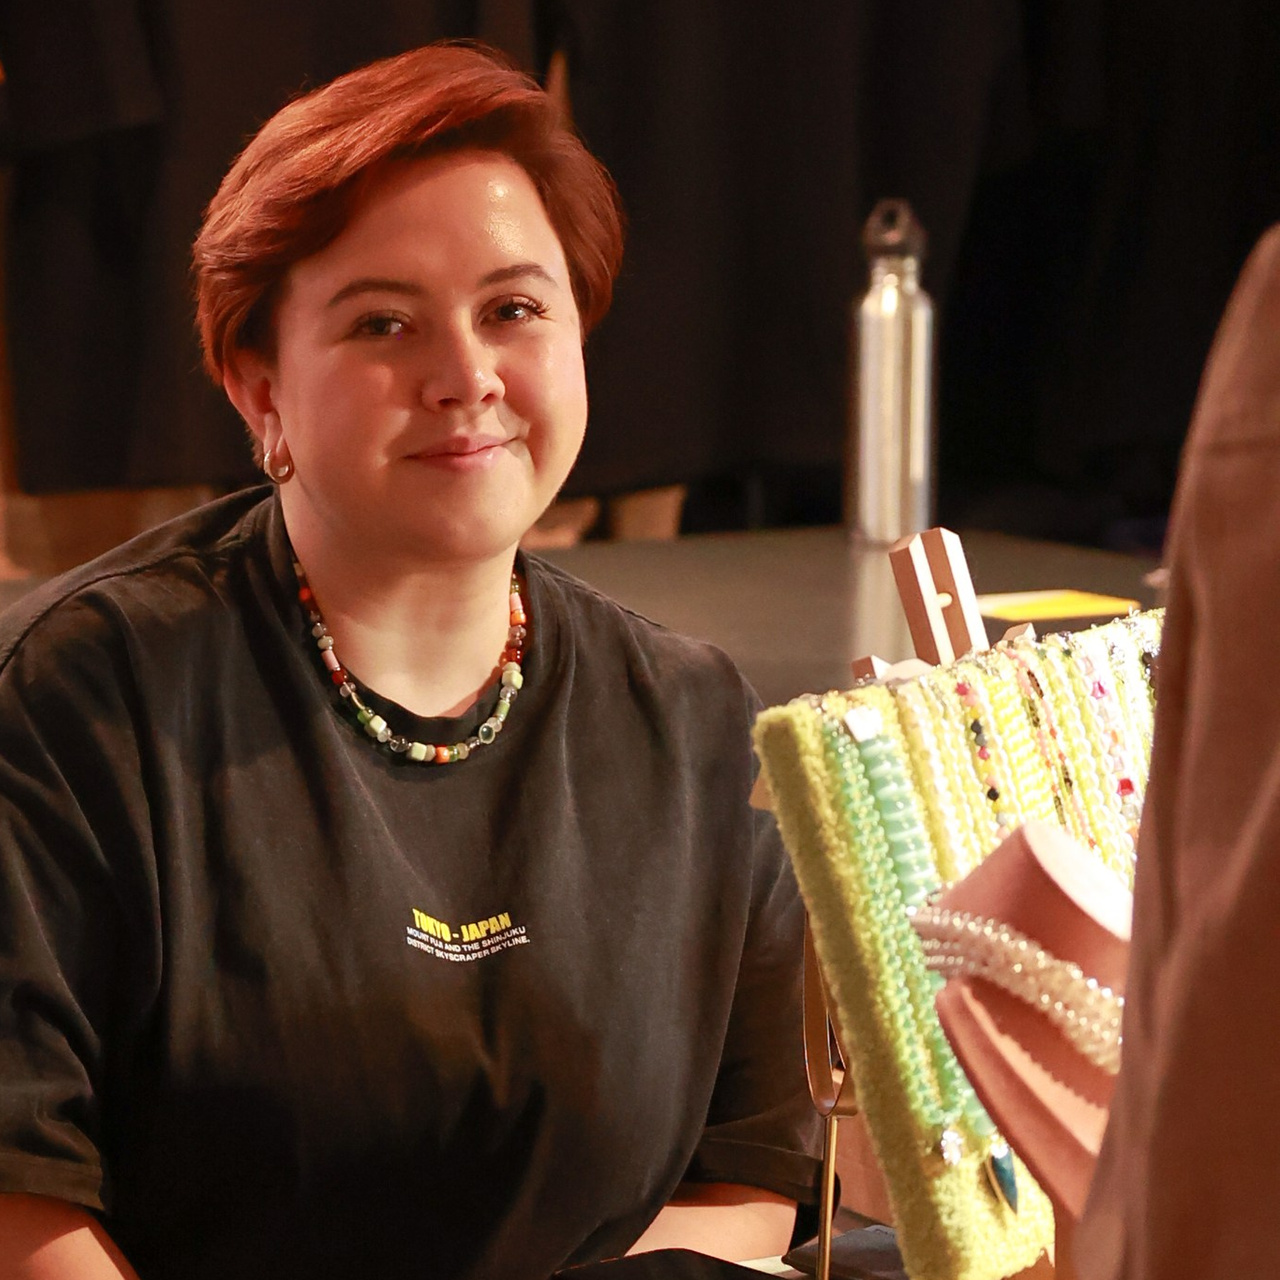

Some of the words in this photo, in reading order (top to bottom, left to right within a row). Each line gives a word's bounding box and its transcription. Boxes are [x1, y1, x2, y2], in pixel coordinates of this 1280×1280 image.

[412, 908, 451, 942] TOKYO
[460, 912, 512, 942] JAPAN
[406, 926, 429, 942] MOUNT
[444, 943, 461, 953] AND
[461, 942, 480, 952] THE
[481, 926, 526, 948] SHINJUKU
[406, 936, 434, 954] DISTRICT
[434, 948, 490, 962] SKYSCRAPER
